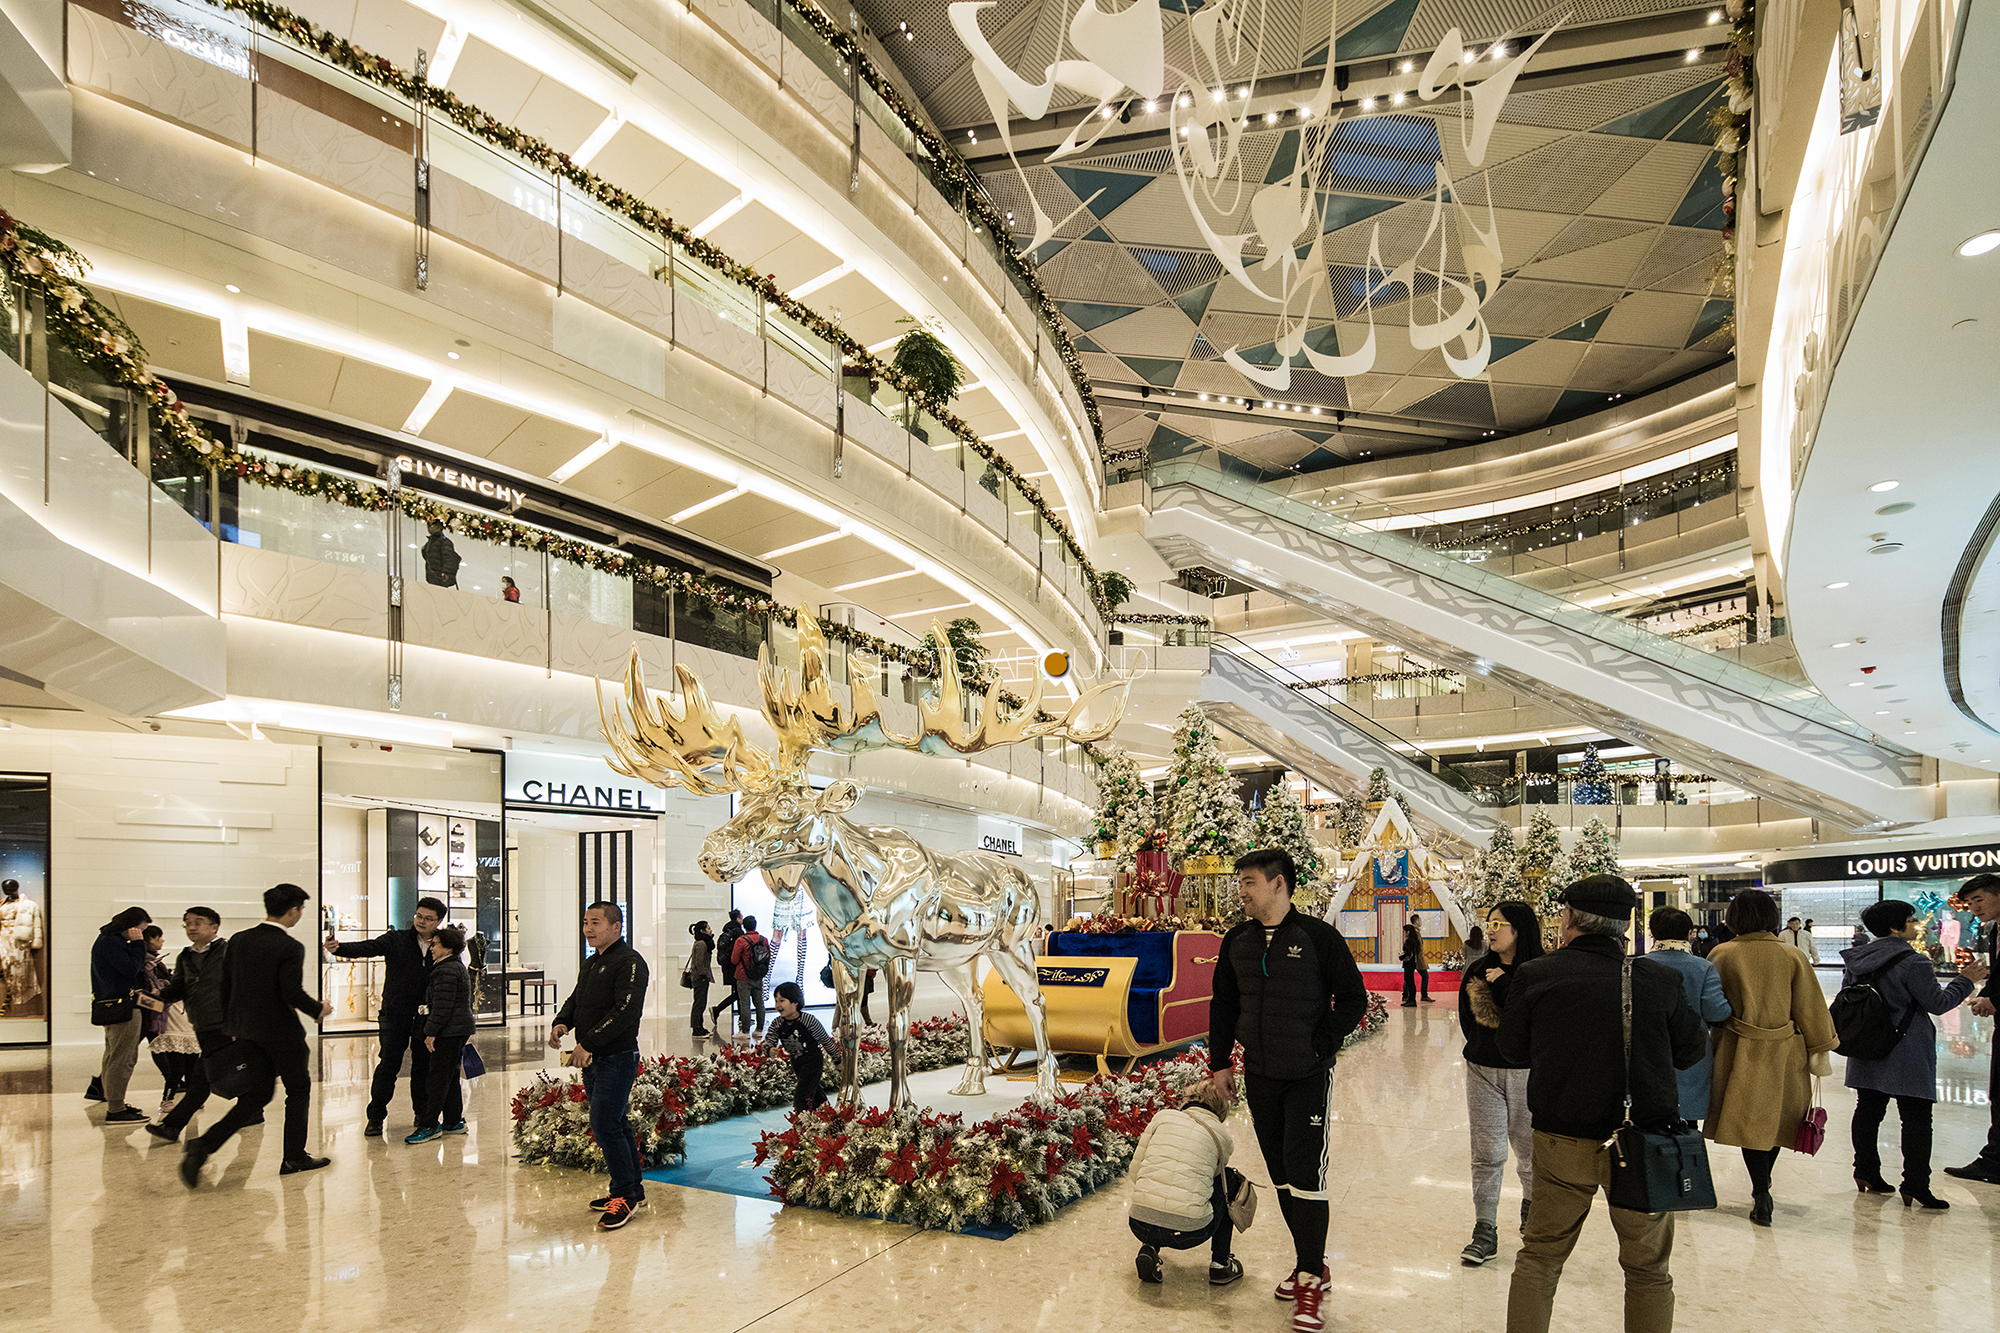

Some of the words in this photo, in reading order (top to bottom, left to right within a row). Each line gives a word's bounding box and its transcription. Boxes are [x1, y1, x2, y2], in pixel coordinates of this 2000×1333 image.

[395, 455, 527, 505] GIVENCHY
[522, 779, 651, 811] CHANEL
[983, 835, 1017, 854] CHANEL
[1847, 856, 1908, 875] LOUIS
[1912, 849, 2000, 872] VUITTON
